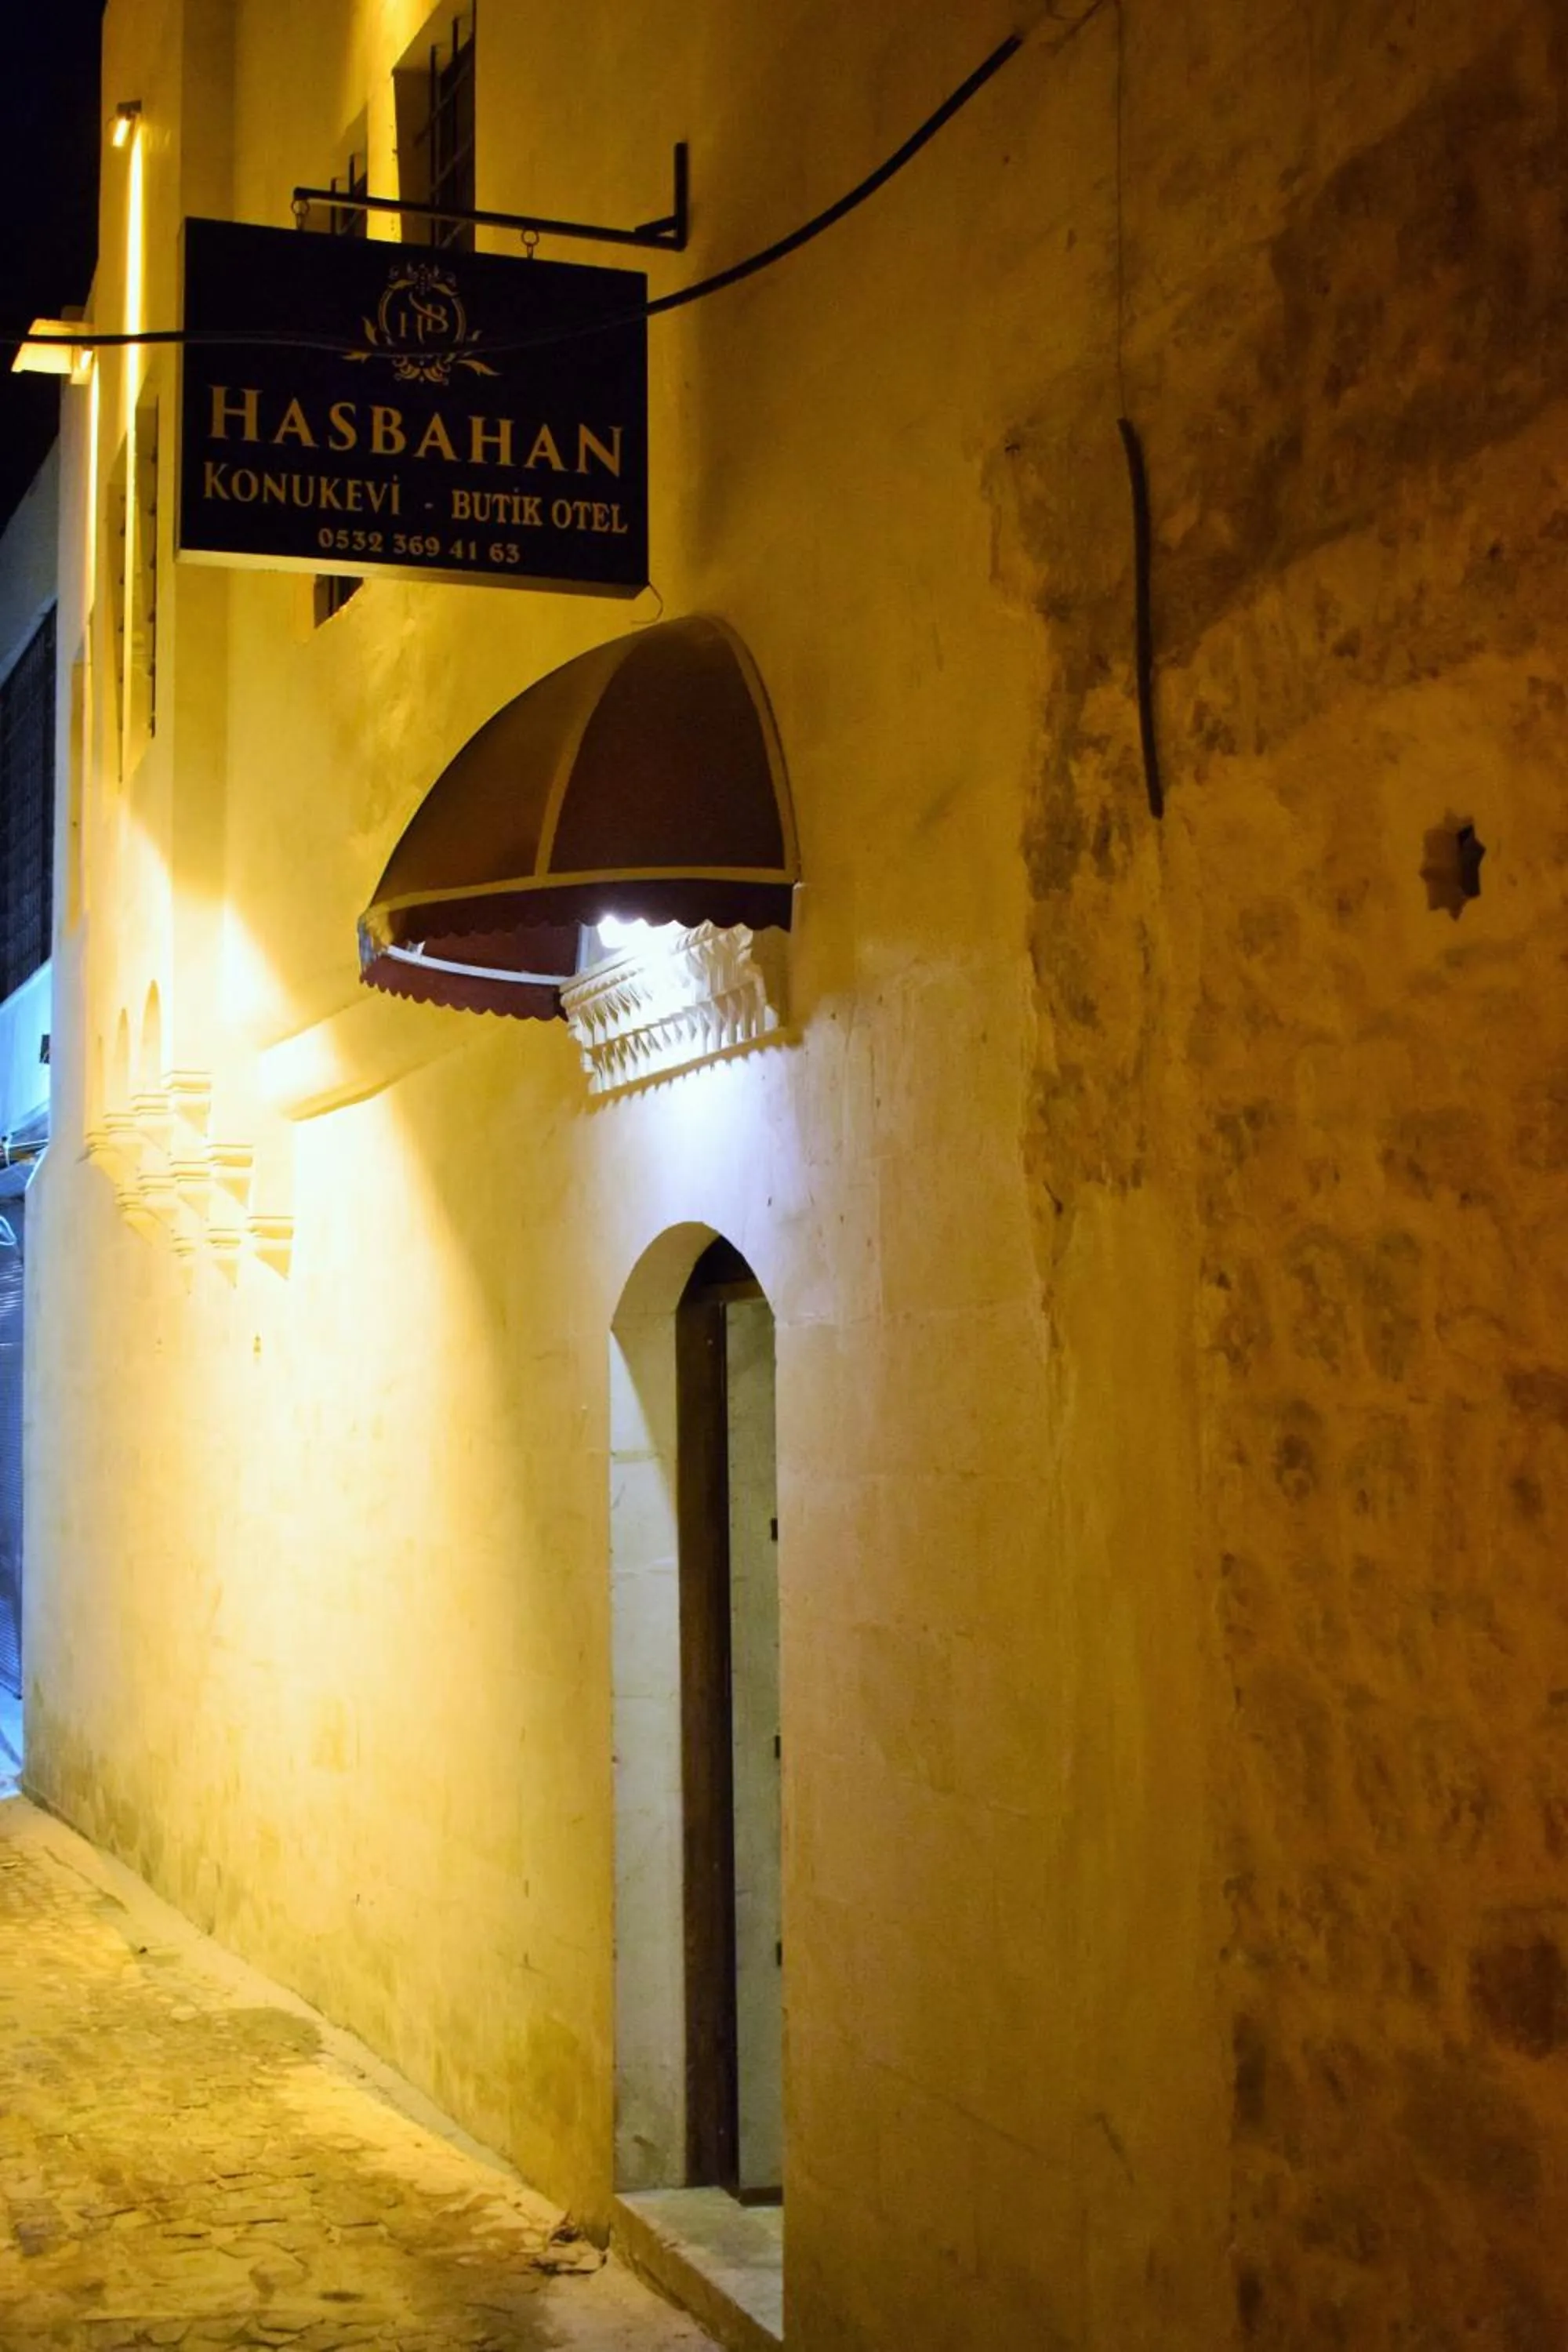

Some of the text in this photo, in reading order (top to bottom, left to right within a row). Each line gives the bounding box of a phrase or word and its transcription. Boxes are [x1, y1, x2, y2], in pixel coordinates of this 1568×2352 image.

[209, 385, 622, 477] HASBAHAN
[204, 462, 400, 515] KONUKEVİ
[452, 487, 543, 527] BUTİK
[553, 499, 628, 534] OTEL
[318, 528, 521, 564] 0532 369 41 63
